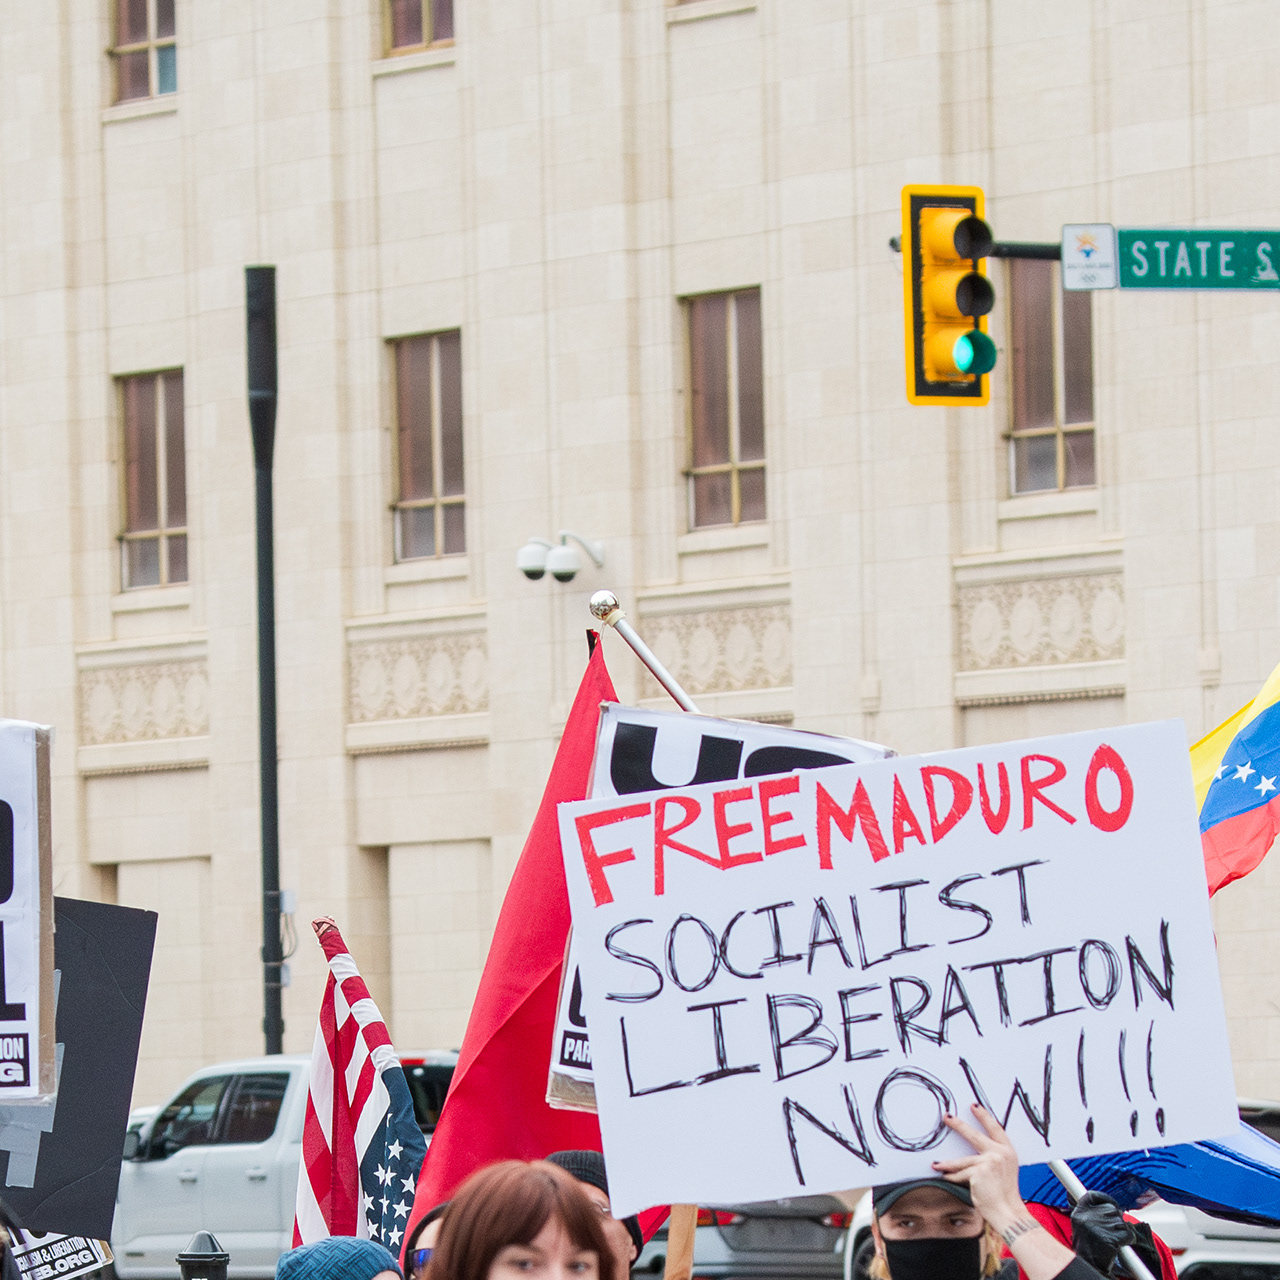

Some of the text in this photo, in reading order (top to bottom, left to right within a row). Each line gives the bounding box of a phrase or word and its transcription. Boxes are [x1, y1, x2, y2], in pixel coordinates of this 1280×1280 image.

[1132, 240, 1236, 277] STATE
[573, 742, 1135, 908] FREE MADURO
[604, 859, 1051, 1003] SOCIALIST
[620, 917, 1178, 1098] LIBERATION
